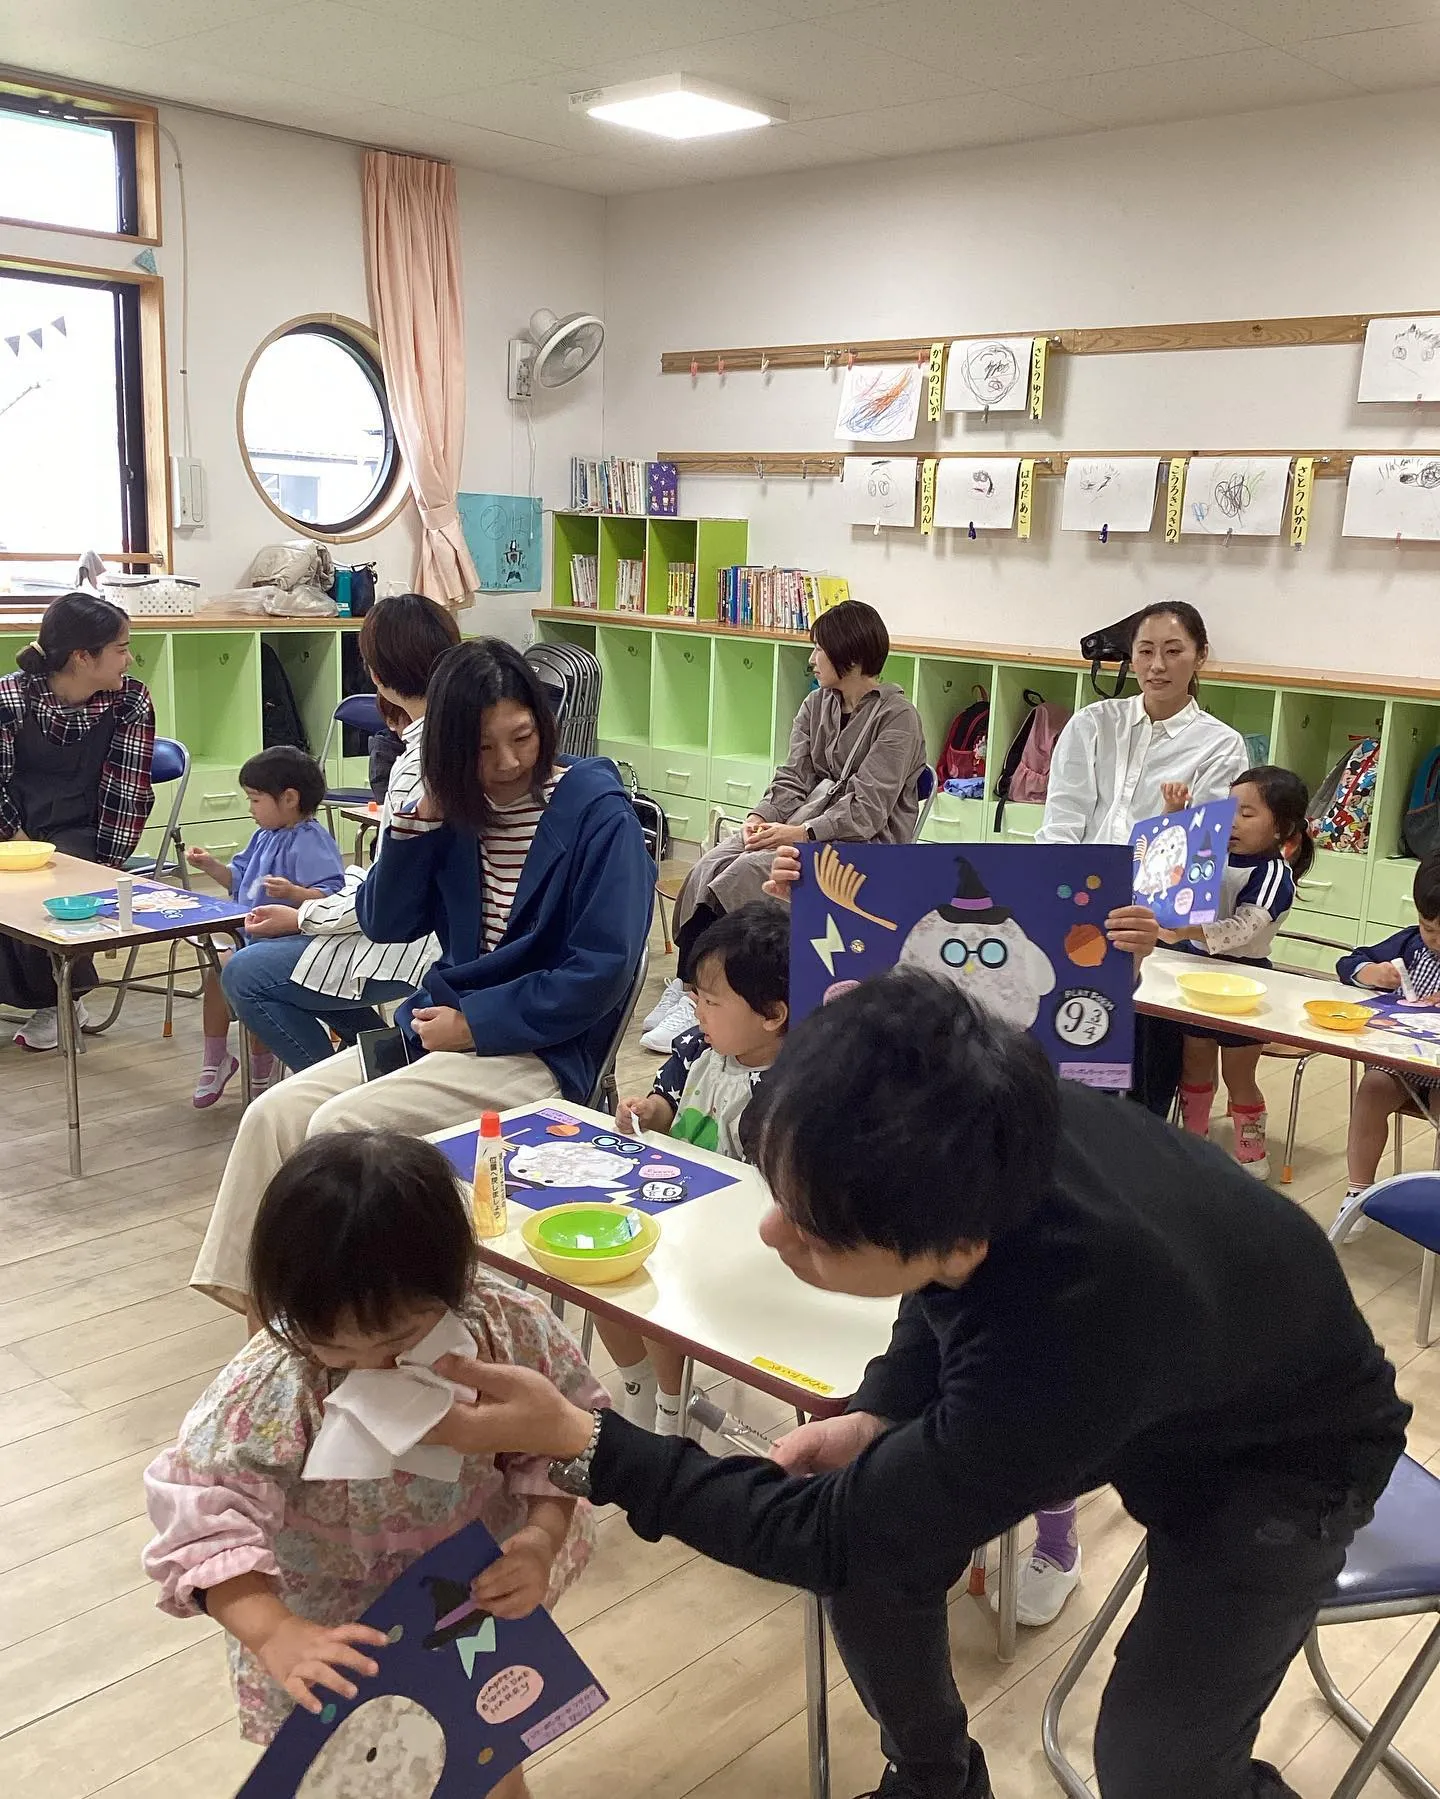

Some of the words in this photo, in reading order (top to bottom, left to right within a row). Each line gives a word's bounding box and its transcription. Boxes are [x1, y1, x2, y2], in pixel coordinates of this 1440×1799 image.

[930, 349, 942, 416] かわのたいが
[1031, 347, 1043, 417] さとうゆうと
[1293, 465, 1308, 538] さとうひかり
